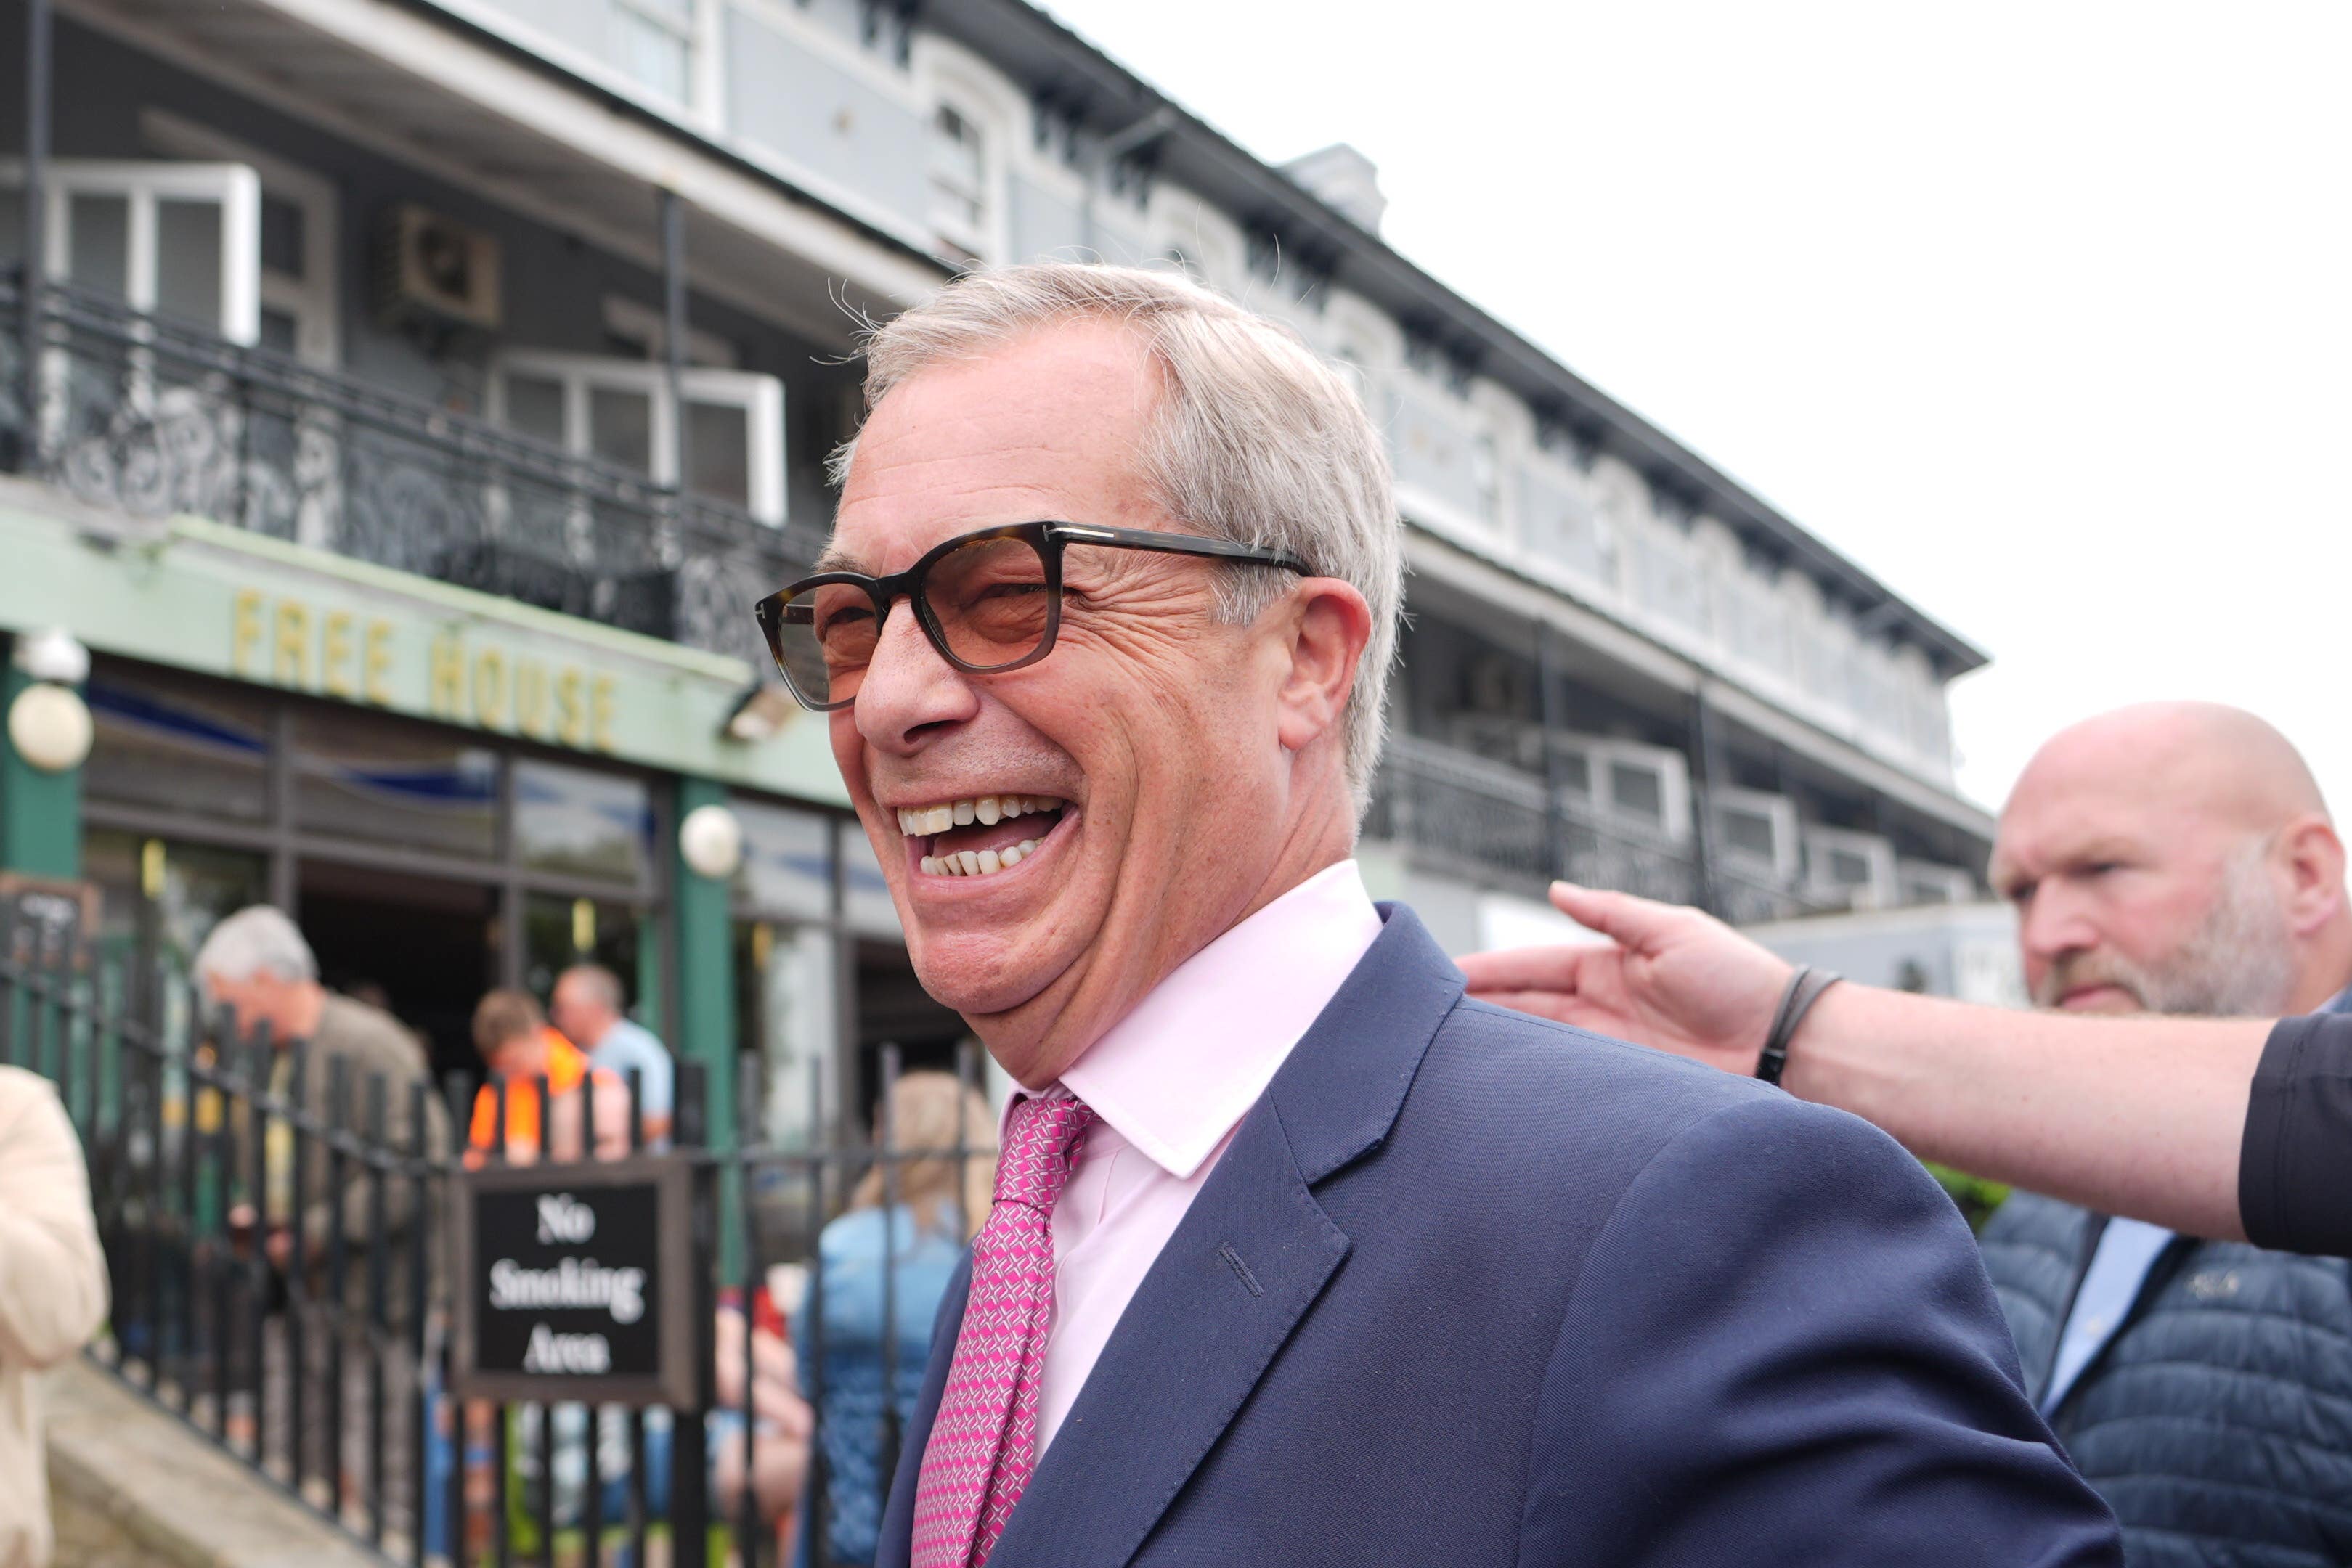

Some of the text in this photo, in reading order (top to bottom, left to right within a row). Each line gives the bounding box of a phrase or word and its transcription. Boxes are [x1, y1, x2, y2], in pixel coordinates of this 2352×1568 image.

[232, 588, 619, 754] FREE HOUSE
[537, 1192, 596, 1246] No
[489, 1257, 647, 1325] Smoking
[523, 1321, 611, 1374] Area
